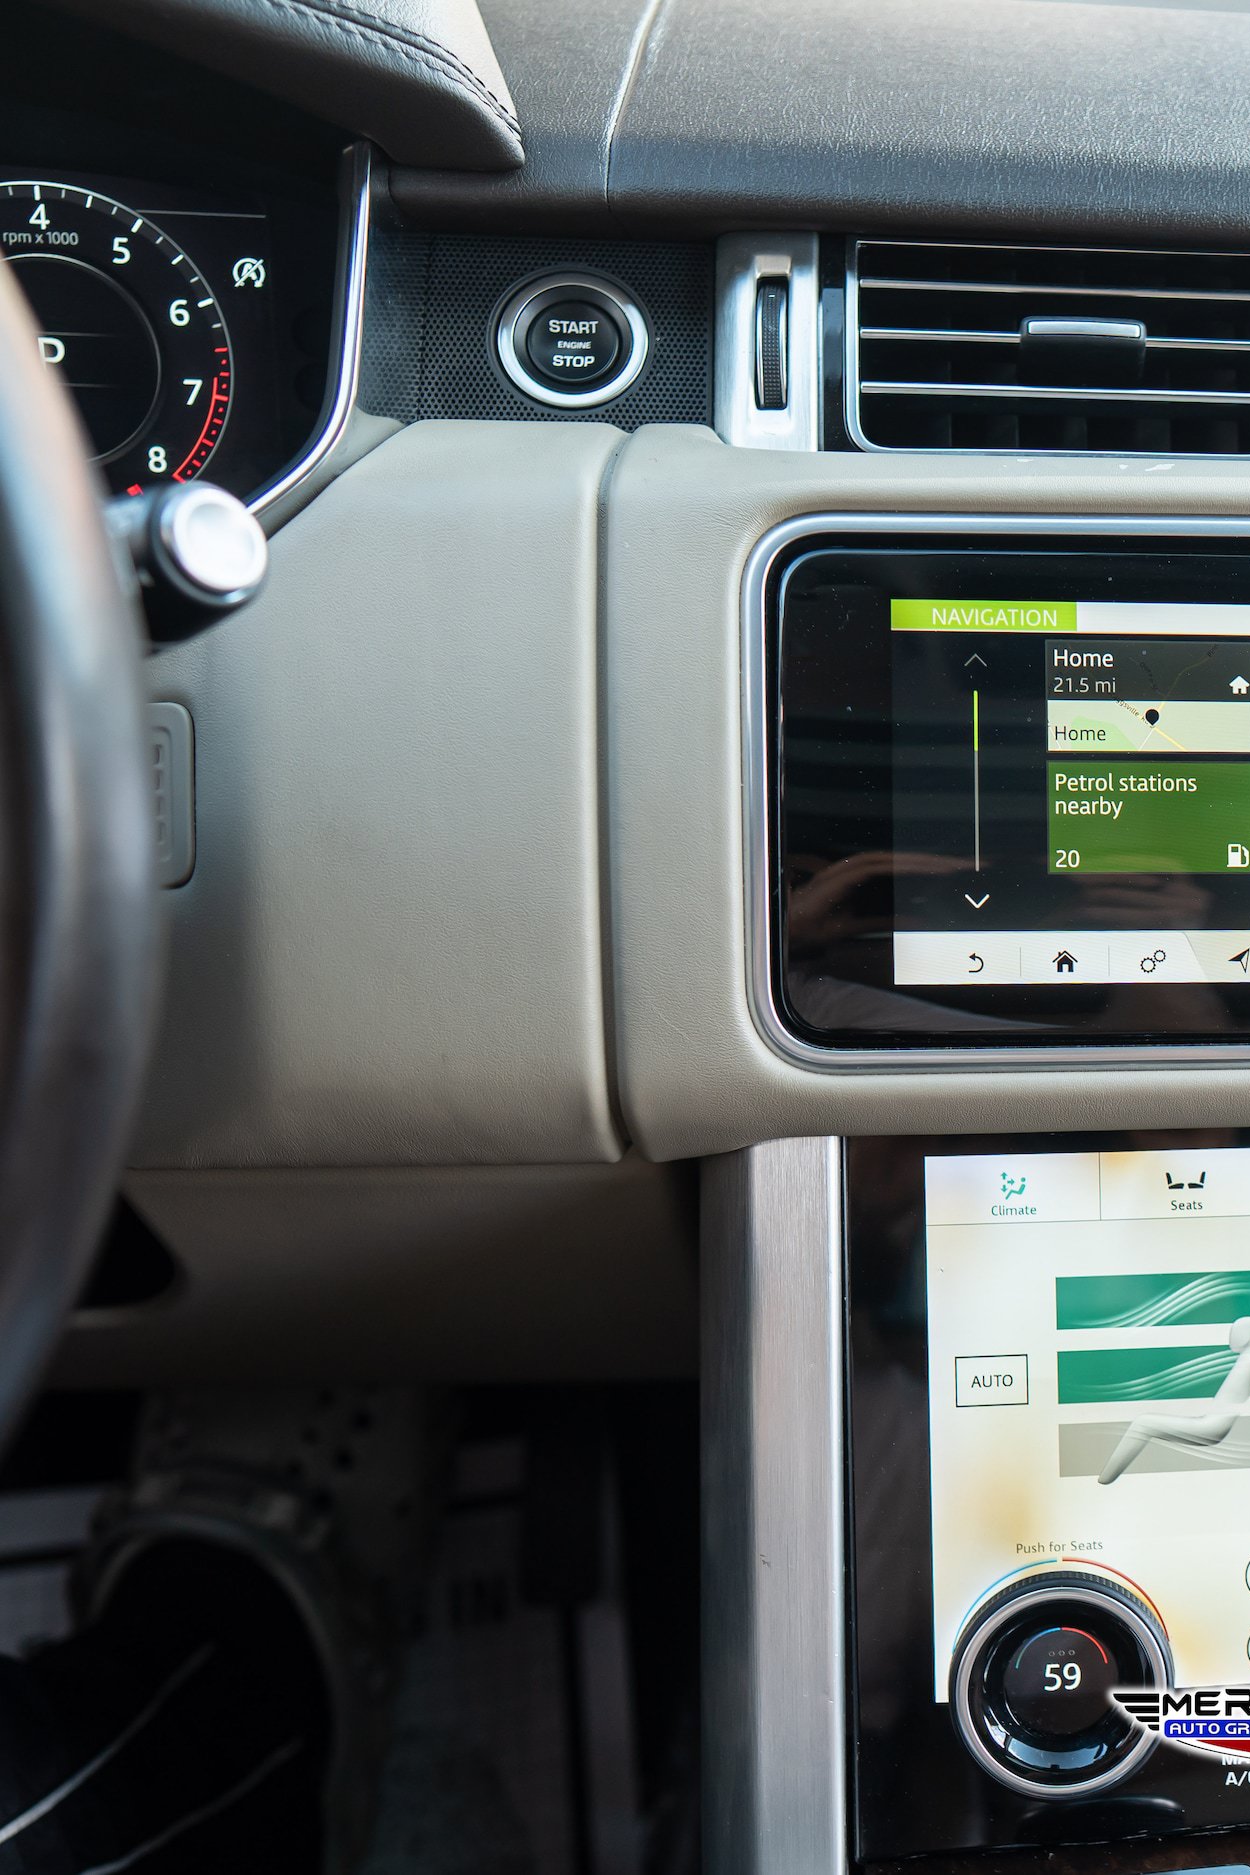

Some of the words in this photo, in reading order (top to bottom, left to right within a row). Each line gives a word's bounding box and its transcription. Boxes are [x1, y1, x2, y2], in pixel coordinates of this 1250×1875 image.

[29, 204, 50, 230] 4
[3, 232, 31, 244] rpm
[35, 235, 44, 243] x
[46, 232, 79, 245] 1000
[112, 237, 131, 264] 5
[169, 299, 190, 327] 6
[548, 319, 599, 334] START
[38, 337, 66, 364] D
[557, 341, 592, 350] ENGINE
[552, 355, 595, 368] STOP
[183, 379, 203, 405] 7
[148, 446, 168, 473] 8
[931, 607, 1058, 628] NAVIGATION
[1053, 649, 1114, 668] Home
[1053, 677, 1089, 693] 21.5
[1095, 677, 1116, 694] mi
[1054, 725, 1106, 742] Home
[1055, 773, 1114, 792] Petrol
[1119, 773, 1197, 793] stations
[1055, 796, 1123, 820] nearby
[1055, 849, 1081, 868] 20
[991, 1203, 1038, 1217] Climate
[1170, 1199, 1203, 1212] Seats
[971, 1373, 1014, 1389] AUTO
[1016, 1543, 1045, 1554] Push
[1049, 1541, 1066, 1552] for
[1070, 1540, 1104, 1552] Seats
[1044, 1662, 1082, 1691] 59
